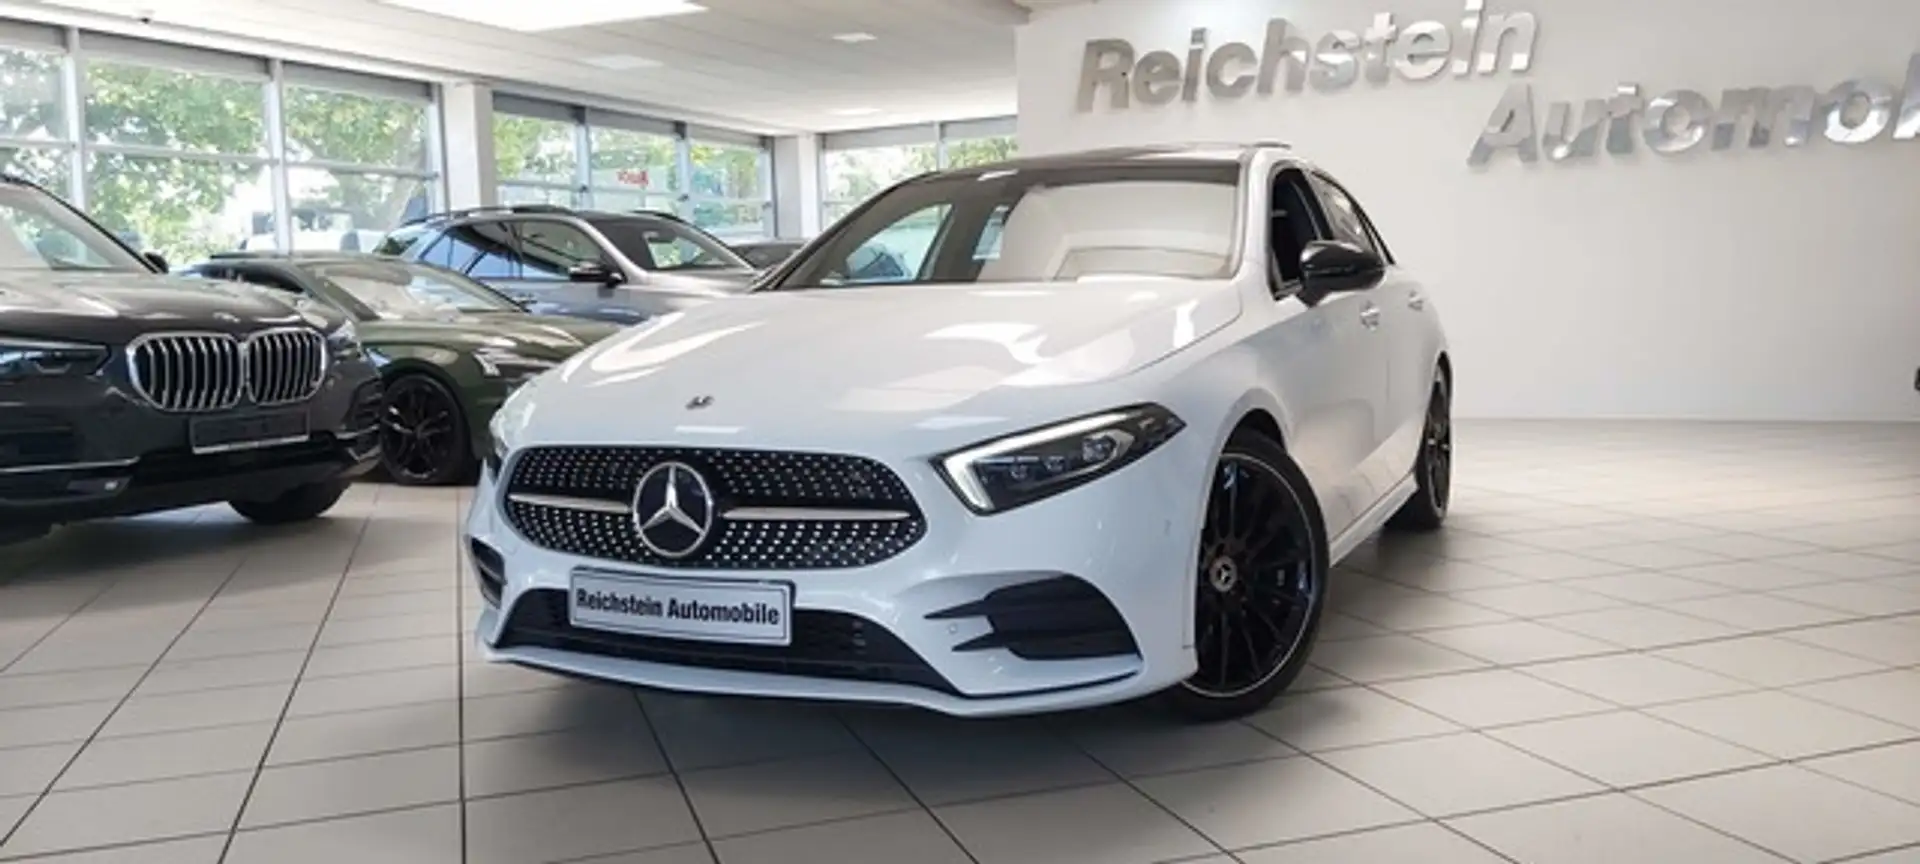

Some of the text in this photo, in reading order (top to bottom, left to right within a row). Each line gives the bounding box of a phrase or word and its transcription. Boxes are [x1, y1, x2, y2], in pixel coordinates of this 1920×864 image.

[1074, 0, 1537, 113] Reichstein
[575, 588, 780, 626] Reichstein Automobile
